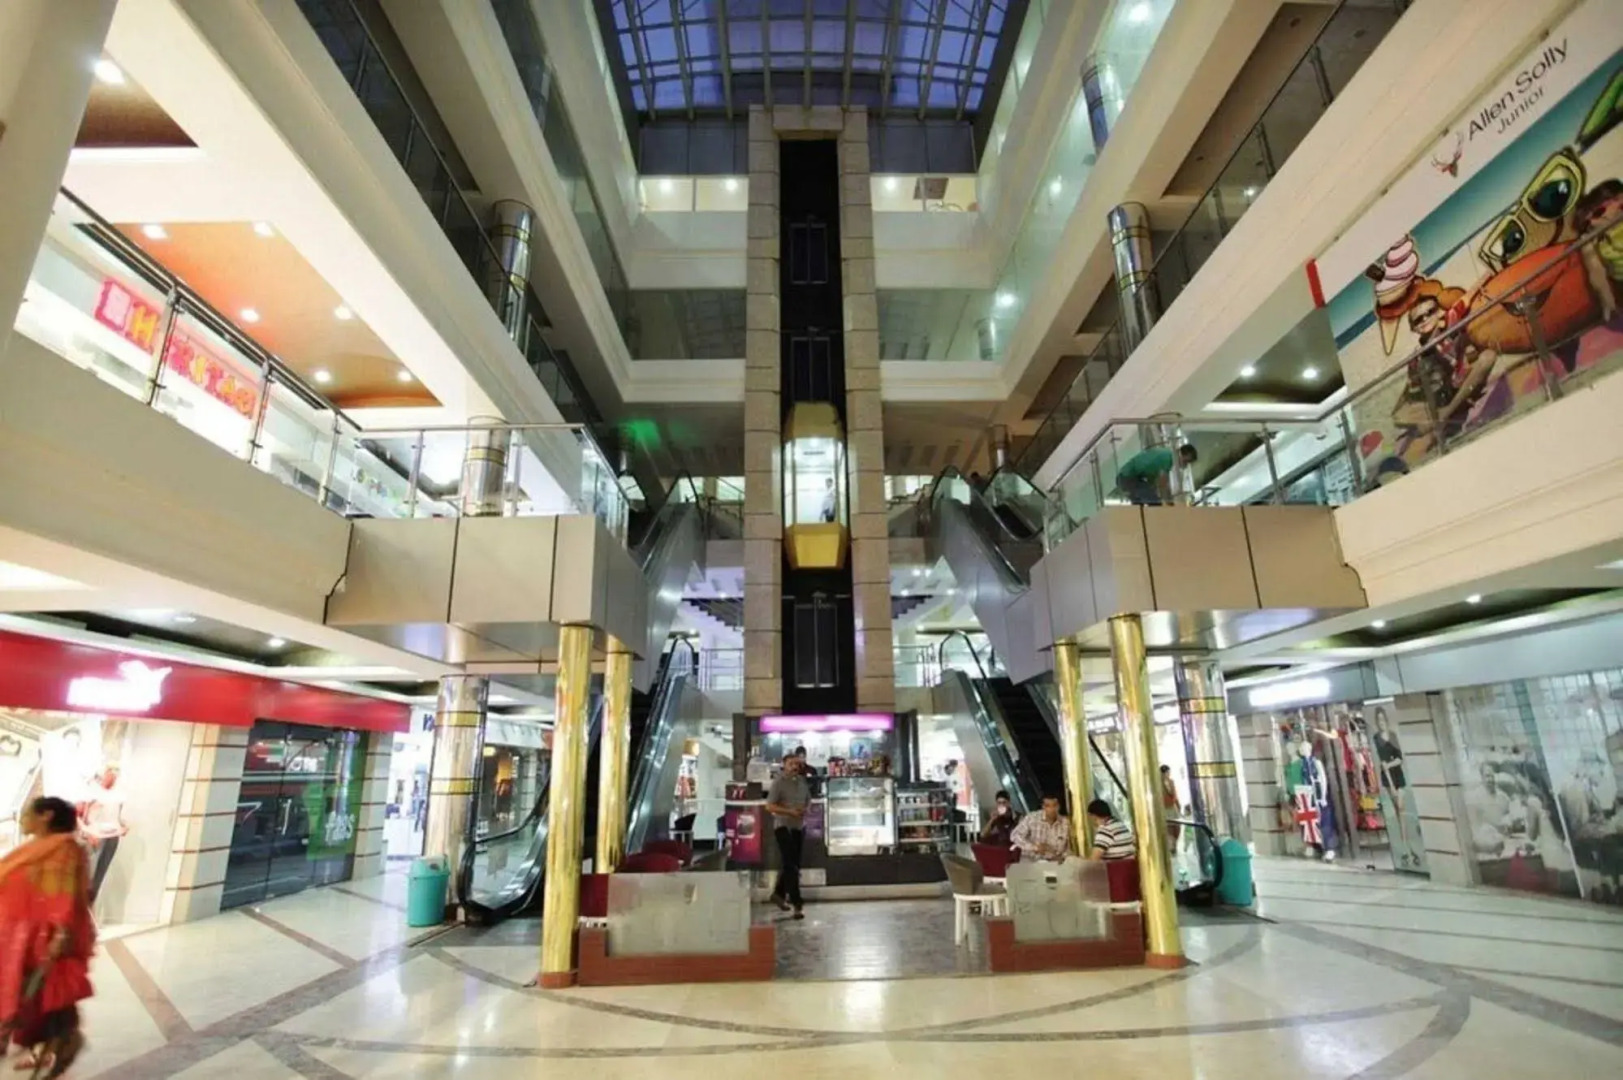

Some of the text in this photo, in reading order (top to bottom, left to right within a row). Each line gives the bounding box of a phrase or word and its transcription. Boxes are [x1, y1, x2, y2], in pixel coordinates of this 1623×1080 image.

[1469, 38, 1567, 141] Allen Solly
[1498, 87, 1544, 134] Junior
